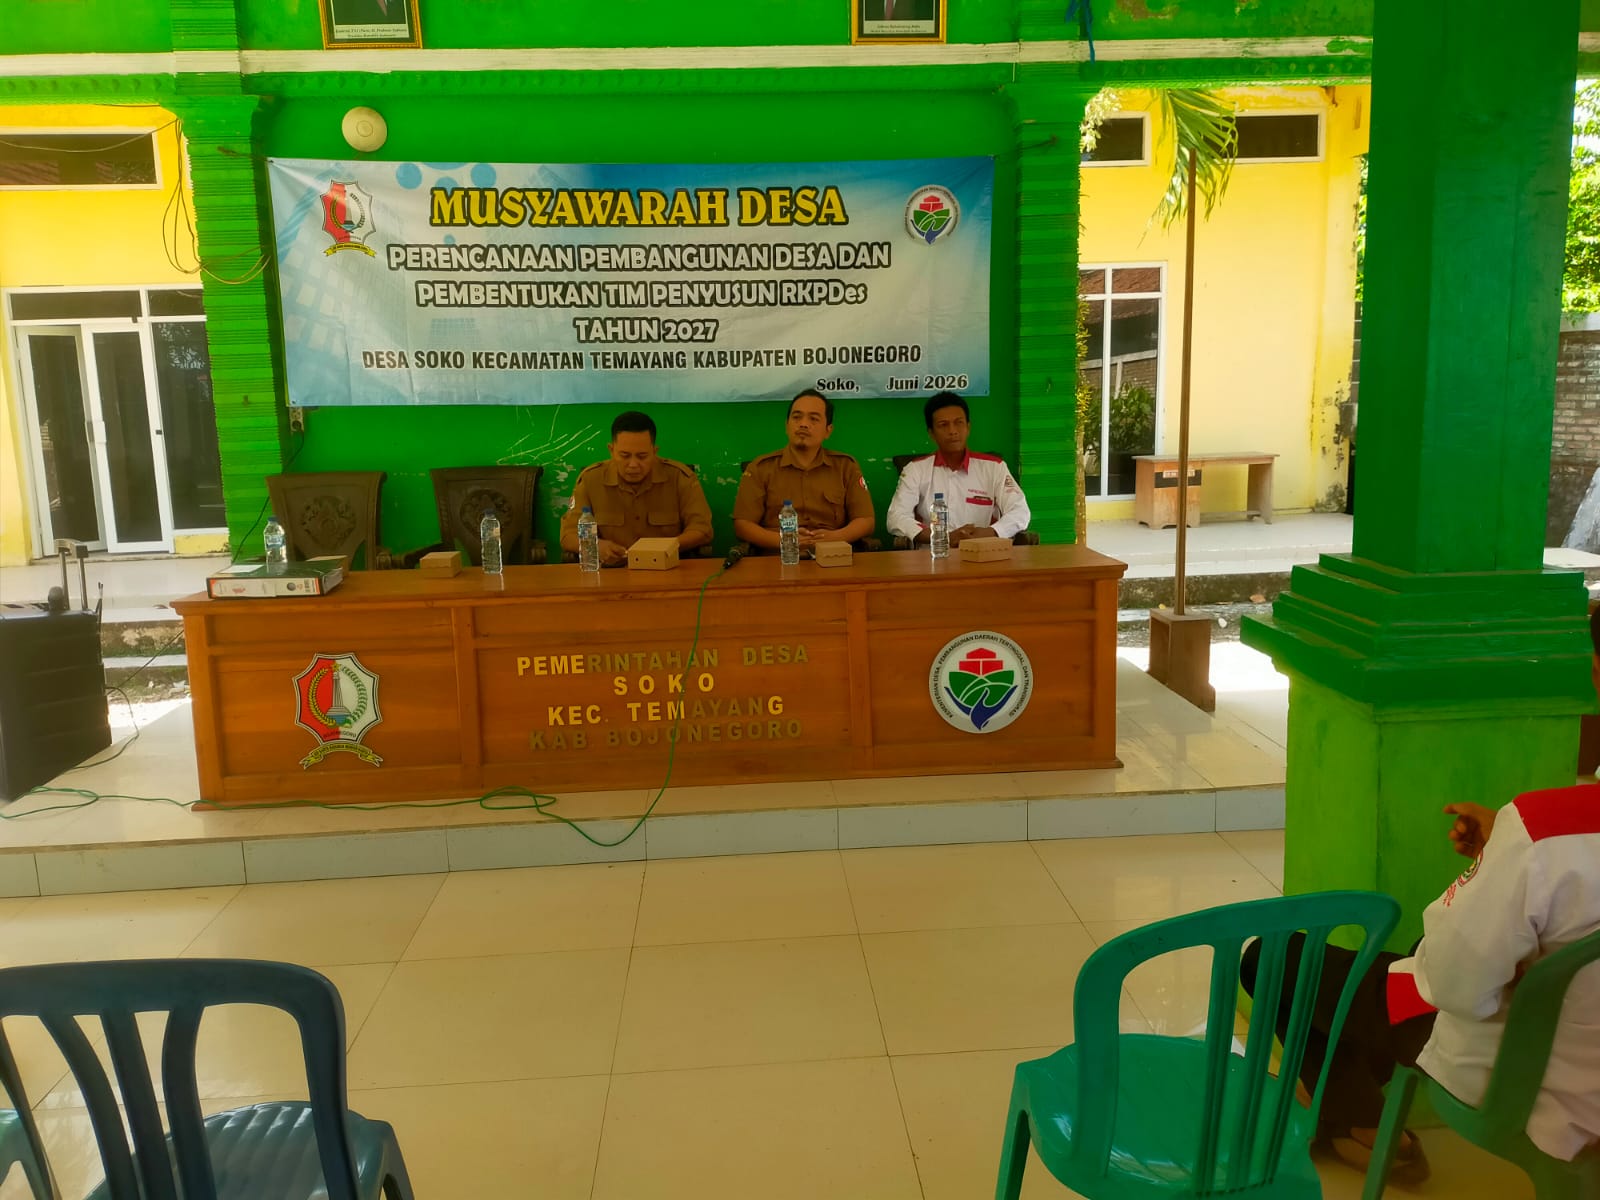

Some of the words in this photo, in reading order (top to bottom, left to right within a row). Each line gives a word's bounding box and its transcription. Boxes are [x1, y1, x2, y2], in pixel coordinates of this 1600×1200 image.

[430, 188, 729, 227] MUSYAWARAH
[738, 186, 849, 226] DESA
[387, 244, 577, 271] PERENCANAAN
[579, 244, 771, 271] PEMBANGUNAN
[774, 243, 837, 270] DESA
[837, 243, 891, 268] DAN
[416, 281, 600, 307] PEMBENTUKAN
[602, 281, 650, 307] TIM
[651, 280, 778, 306] PENYUSUN
[780, 279, 868, 306] RKPDes
[573, 317, 662, 342] TAHUN
[662, 318, 719, 342] 2027
[362, 351, 409, 370] DESA
[414, 351, 465, 370] SOKO
[472, 352, 583, 370] KECAMATAN
[590, 350, 686, 370] TEMAYANG
[693, 349, 796, 368] KABUPATEN
[803, 345, 921, 365] BOJONEGORO
[816, 377, 859, 392] Soko,
[886, 376, 919, 391] Juni
[923, 375, 968, 390] 2026
[517, 649, 719, 676] PEMERINTAHAN
[742, 644, 809, 666] DESA
[627, 696, 783, 722] TEMAYANG
[529, 730, 588, 750] KAB
[607, 719, 801, 748] BOJONEGORO
